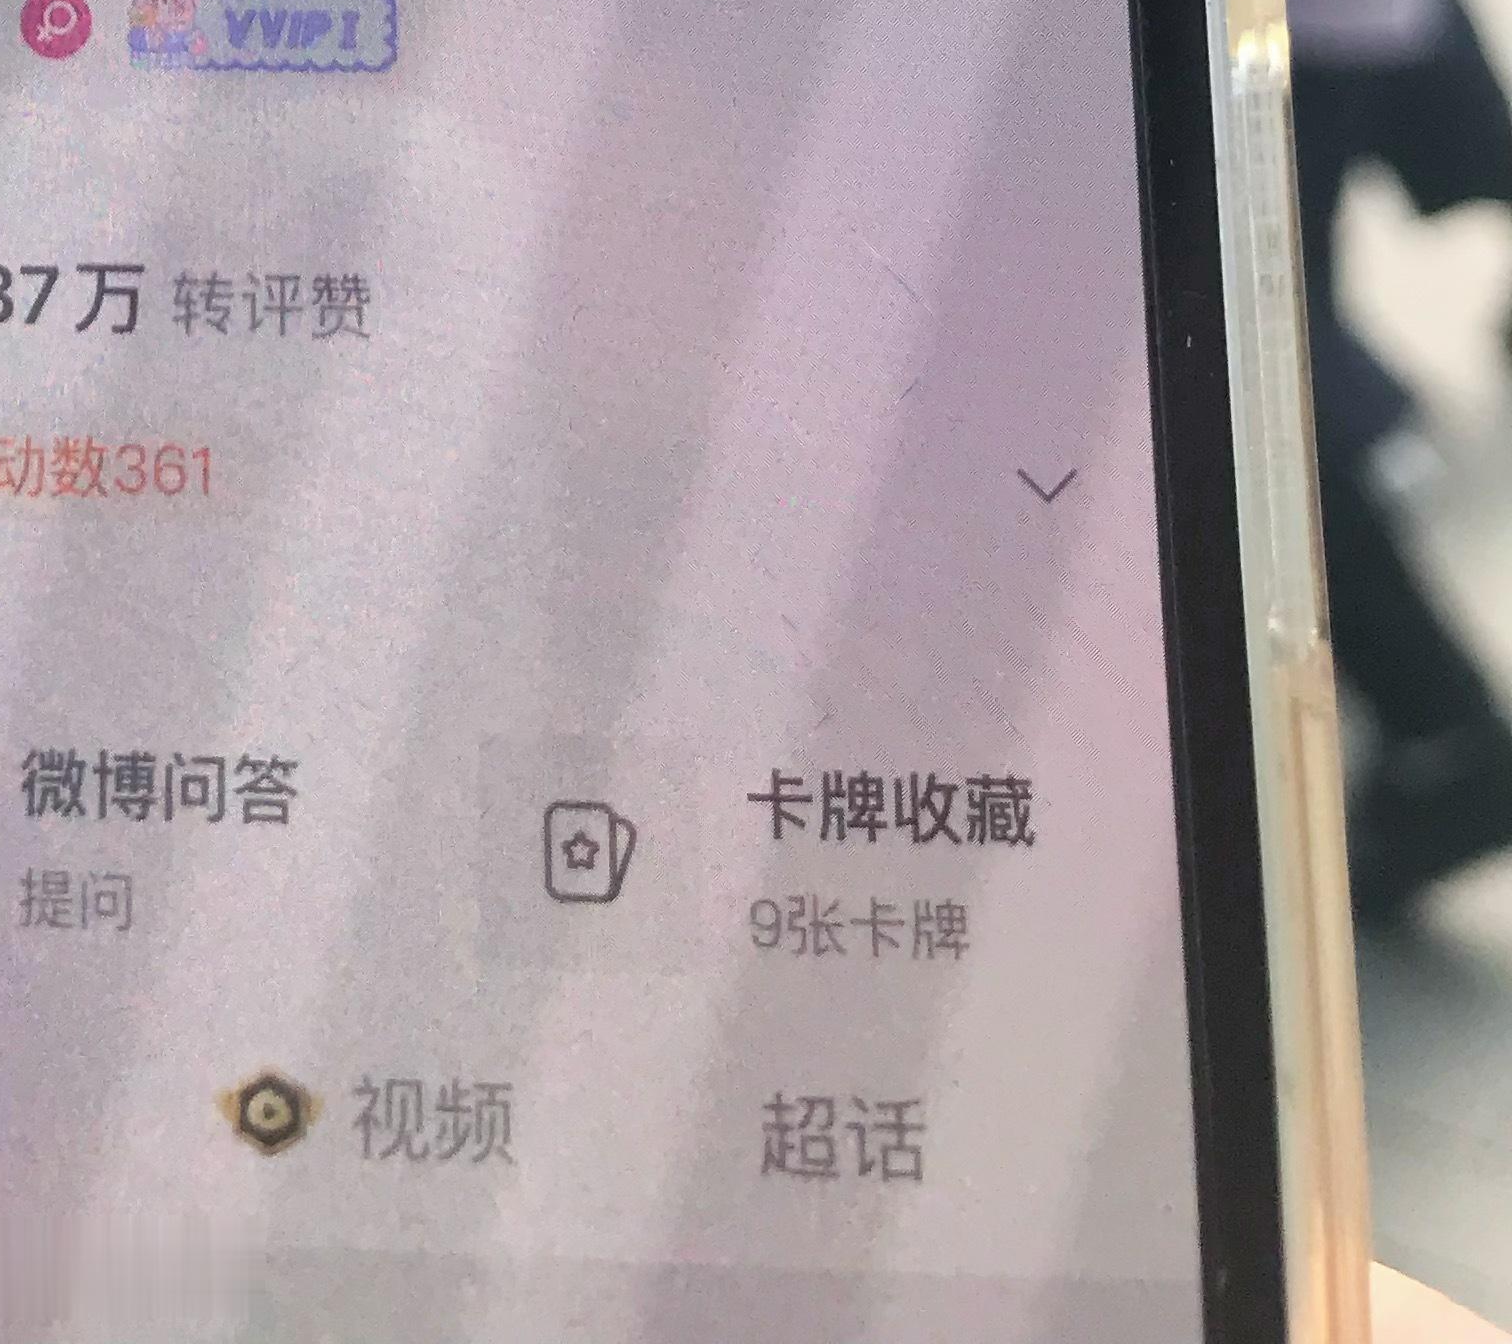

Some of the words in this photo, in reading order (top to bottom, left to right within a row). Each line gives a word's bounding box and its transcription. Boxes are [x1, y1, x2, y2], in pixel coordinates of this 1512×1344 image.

[172, 269, 372, 339] 转评赞
[21, 747, 300, 825] 微博问答
[747, 769, 1035, 847] 卡牌收藏
[18, 866, 135, 932] 提问
[750, 895, 970, 960] 9张卡牌
[352, 1075, 517, 1164] 视频
[760, 1091, 928, 1184] 超话
